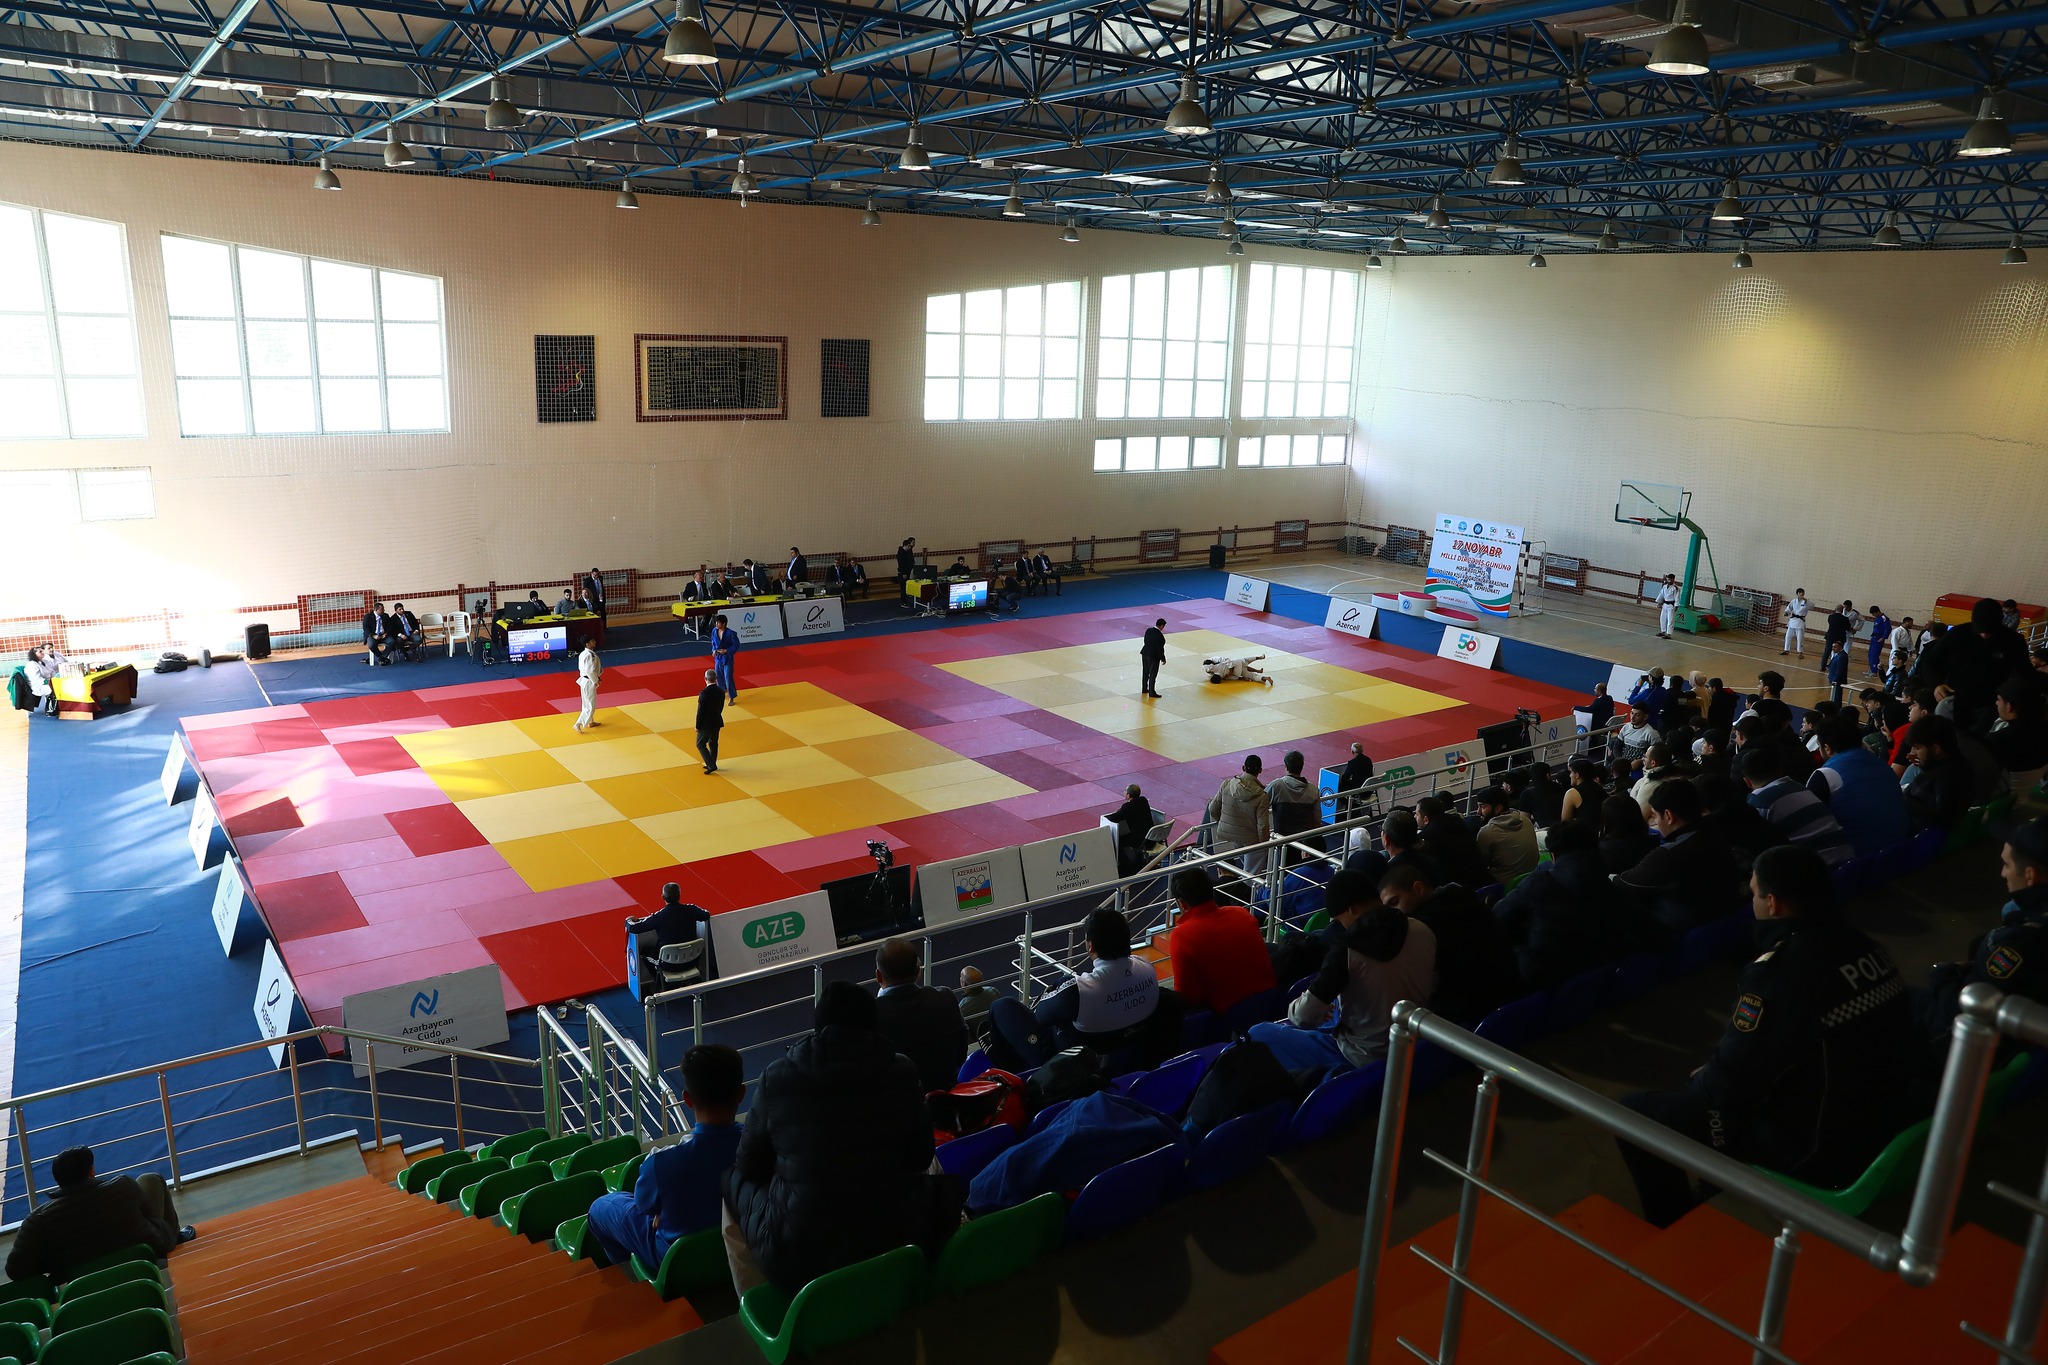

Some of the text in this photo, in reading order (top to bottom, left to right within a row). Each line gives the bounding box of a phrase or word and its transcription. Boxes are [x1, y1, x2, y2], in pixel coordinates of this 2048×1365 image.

[1452, 539, 1503, 558] 17 NOYABR
[960, 600, 975, 608] 1:58
[802, 620, 831, 631] Azercell
[1336, 620, 1360, 631] Azercell
[543, 631, 549, 639] 0
[543, 642, 550, 650] 0
[527, 650, 550, 662] 3:06
[957, 865, 988, 877] AZERBAIJAN
[755, 916, 796, 943] AZE
[1106, 976, 1154, 1004] AZERBAIJAN
[1124, 995, 1146, 1012] JUDO
